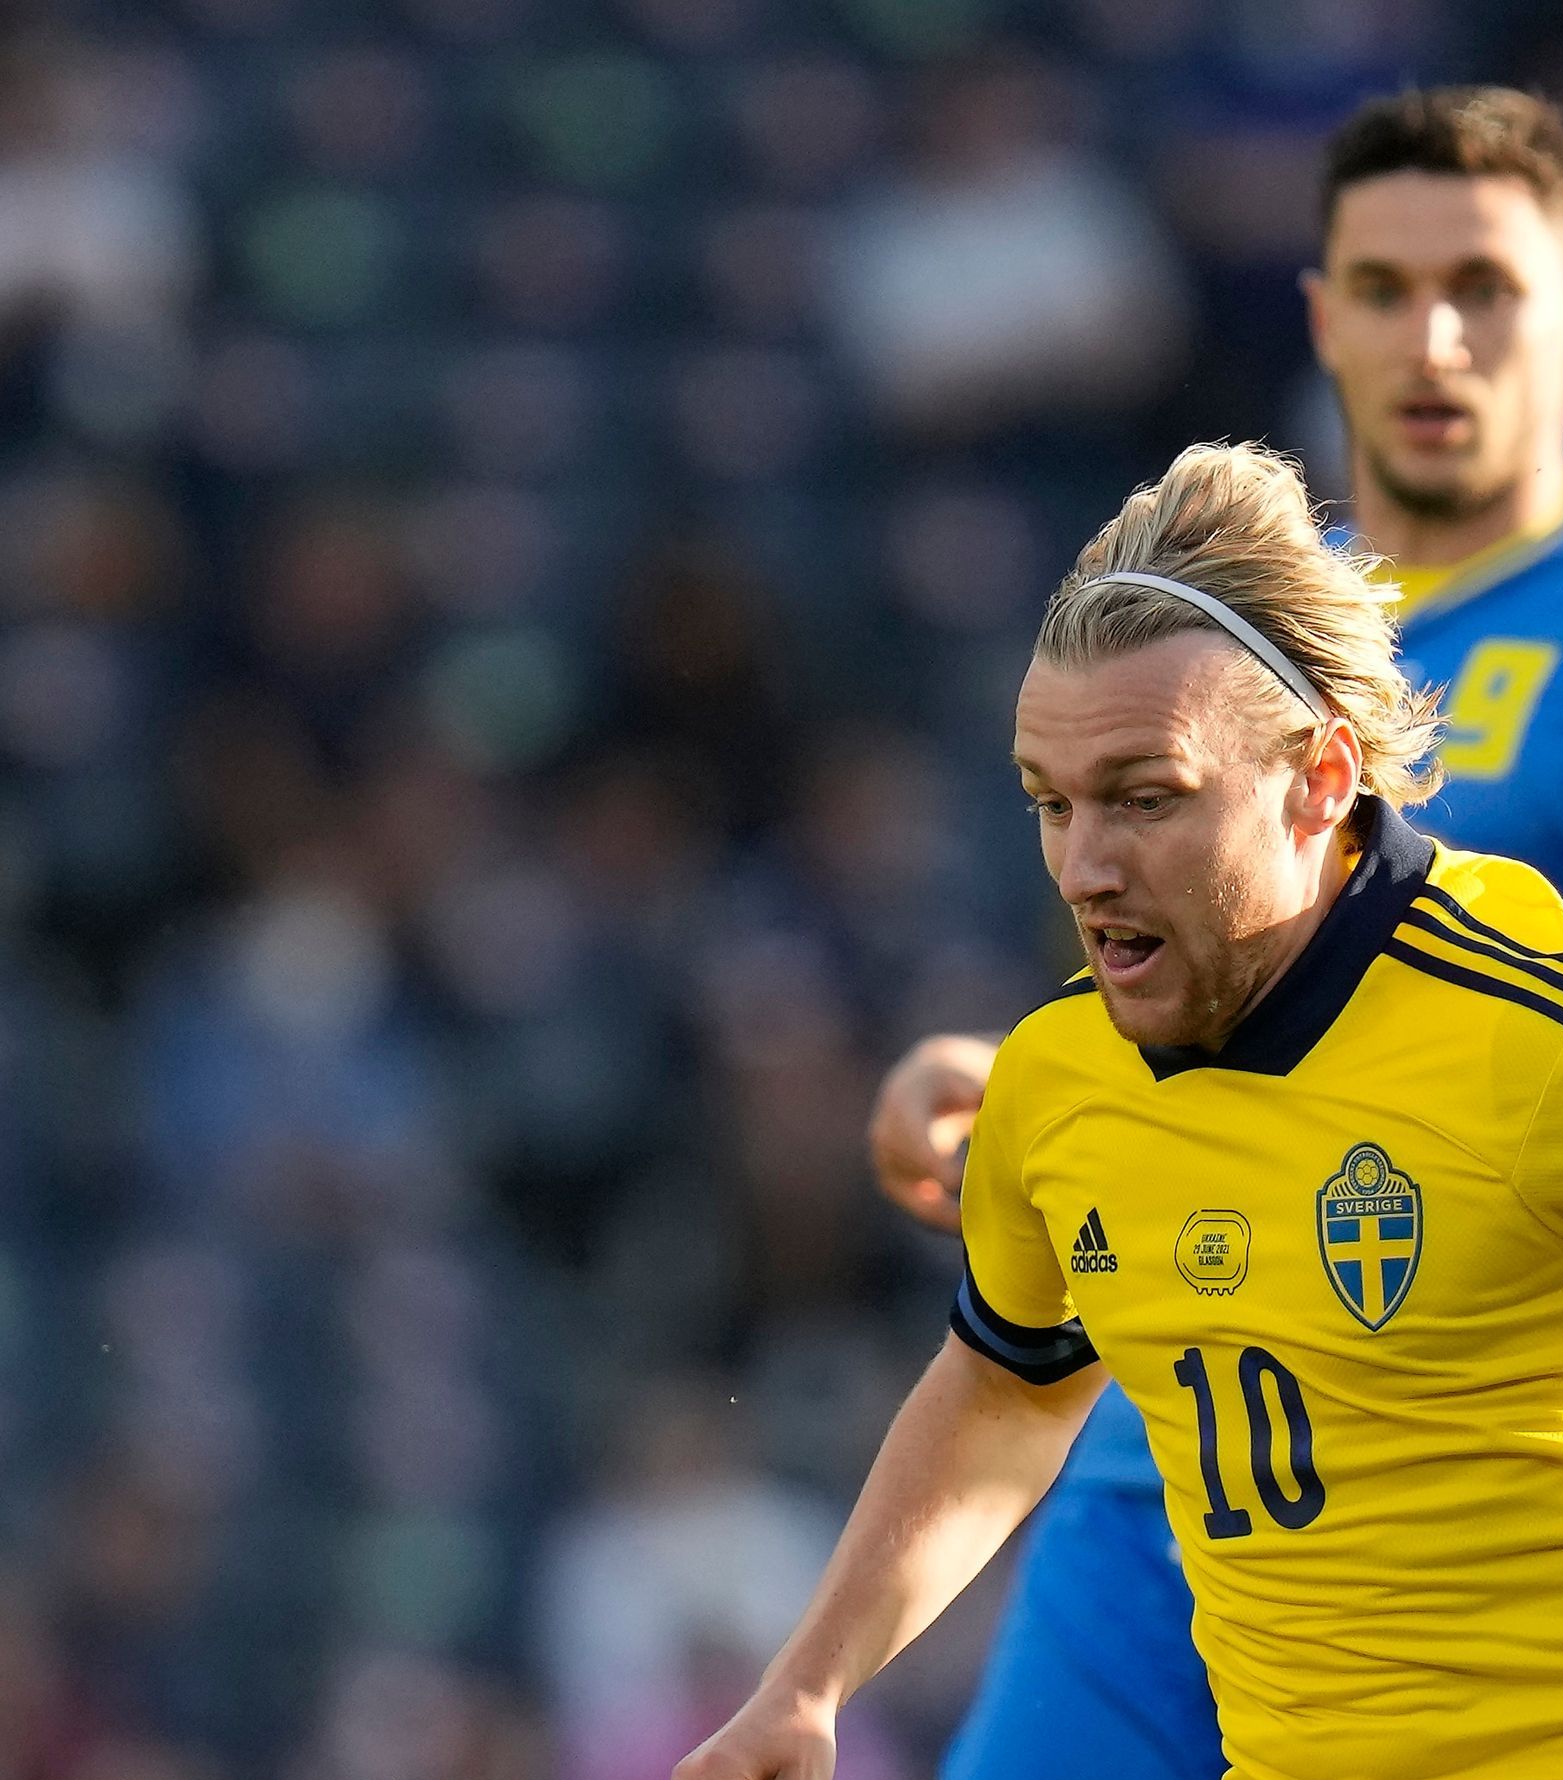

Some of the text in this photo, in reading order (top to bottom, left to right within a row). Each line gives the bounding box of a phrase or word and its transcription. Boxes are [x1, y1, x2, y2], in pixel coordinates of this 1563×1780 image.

[1439, 638, 1560, 777] 9
[1336, 1199, 1403, 1214] SVERIGE
[1071, 1250, 1118, 1273] adidas
[1173, 1346, 1326, 1539] 10
